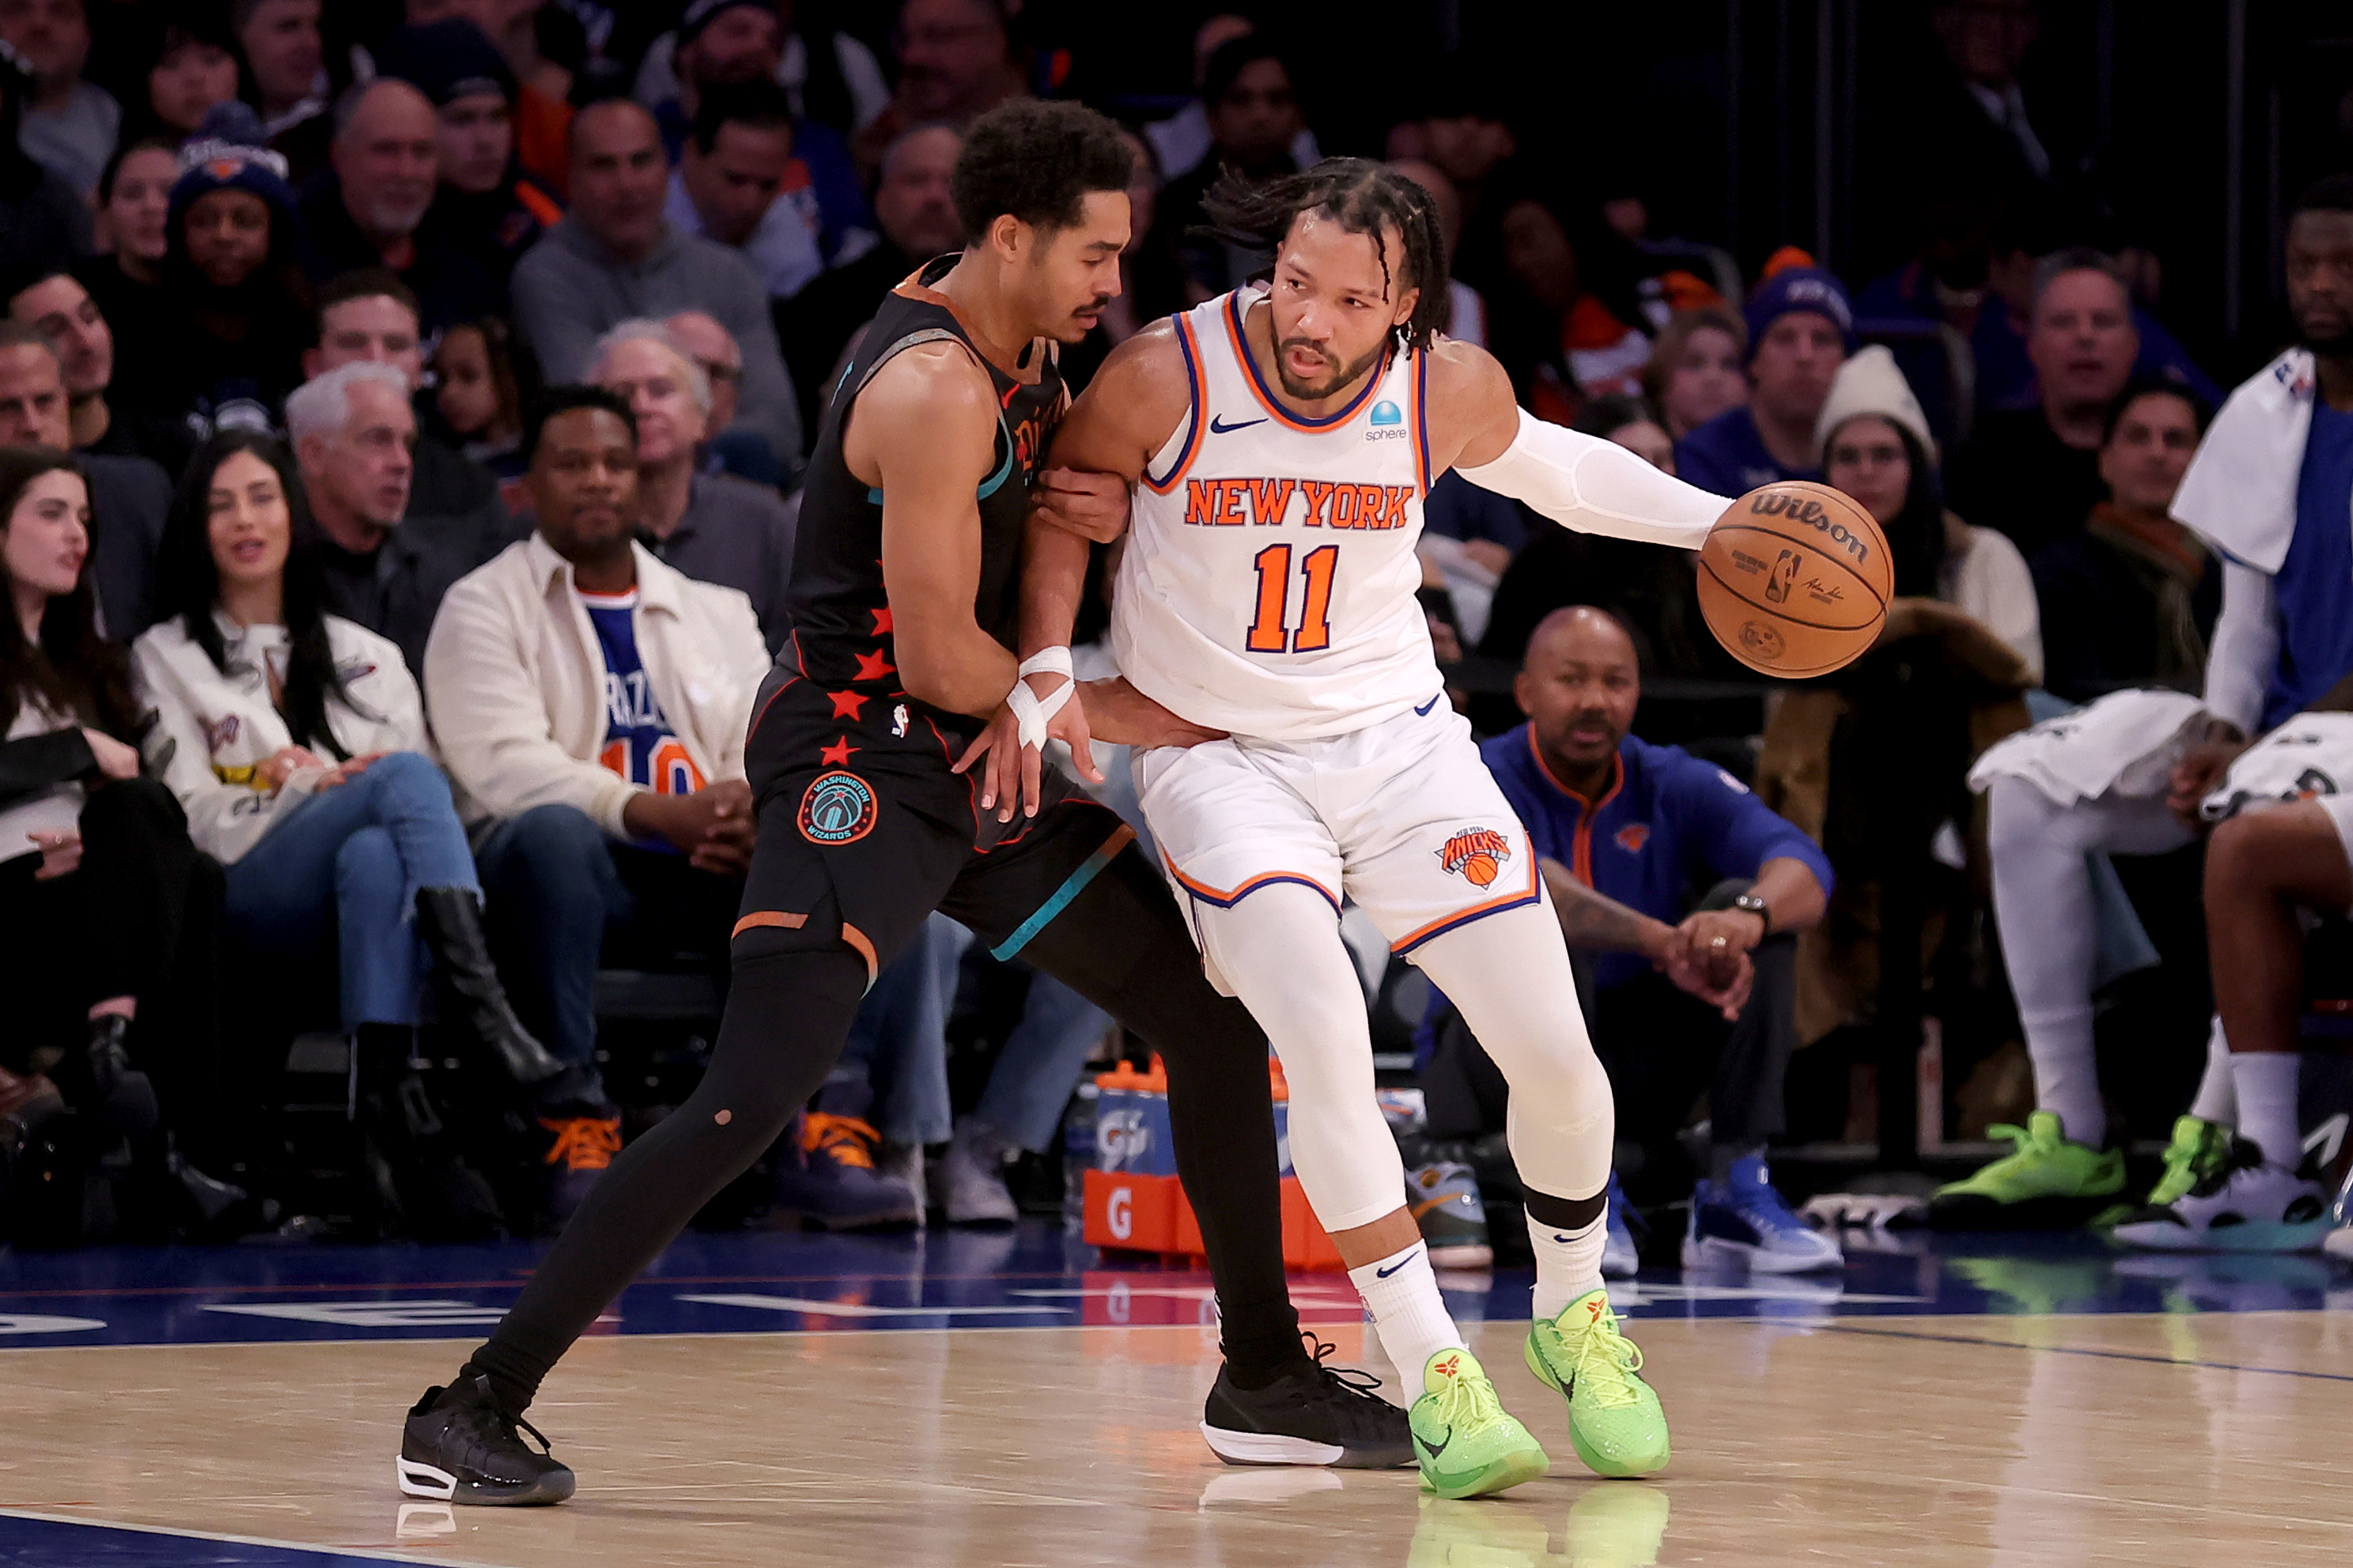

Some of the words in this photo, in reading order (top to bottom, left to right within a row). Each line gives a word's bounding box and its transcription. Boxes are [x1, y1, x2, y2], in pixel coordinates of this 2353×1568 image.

[1365, 429, 1407, 443] sphere
[1184, 477, 1296, 527] NEW
[1299, 479, 1416, 531] YORK
[1750, 493, 1869, 567] Wilson
[1246, 543, 1340, 654] 11
[813, 775, 870, 803] WASHINGTON
[807, 825, 853, 840] WIZARDS
[1442, 829, 1511, 871] KNICKS
[1108, 1186, 1132, 1241] G
